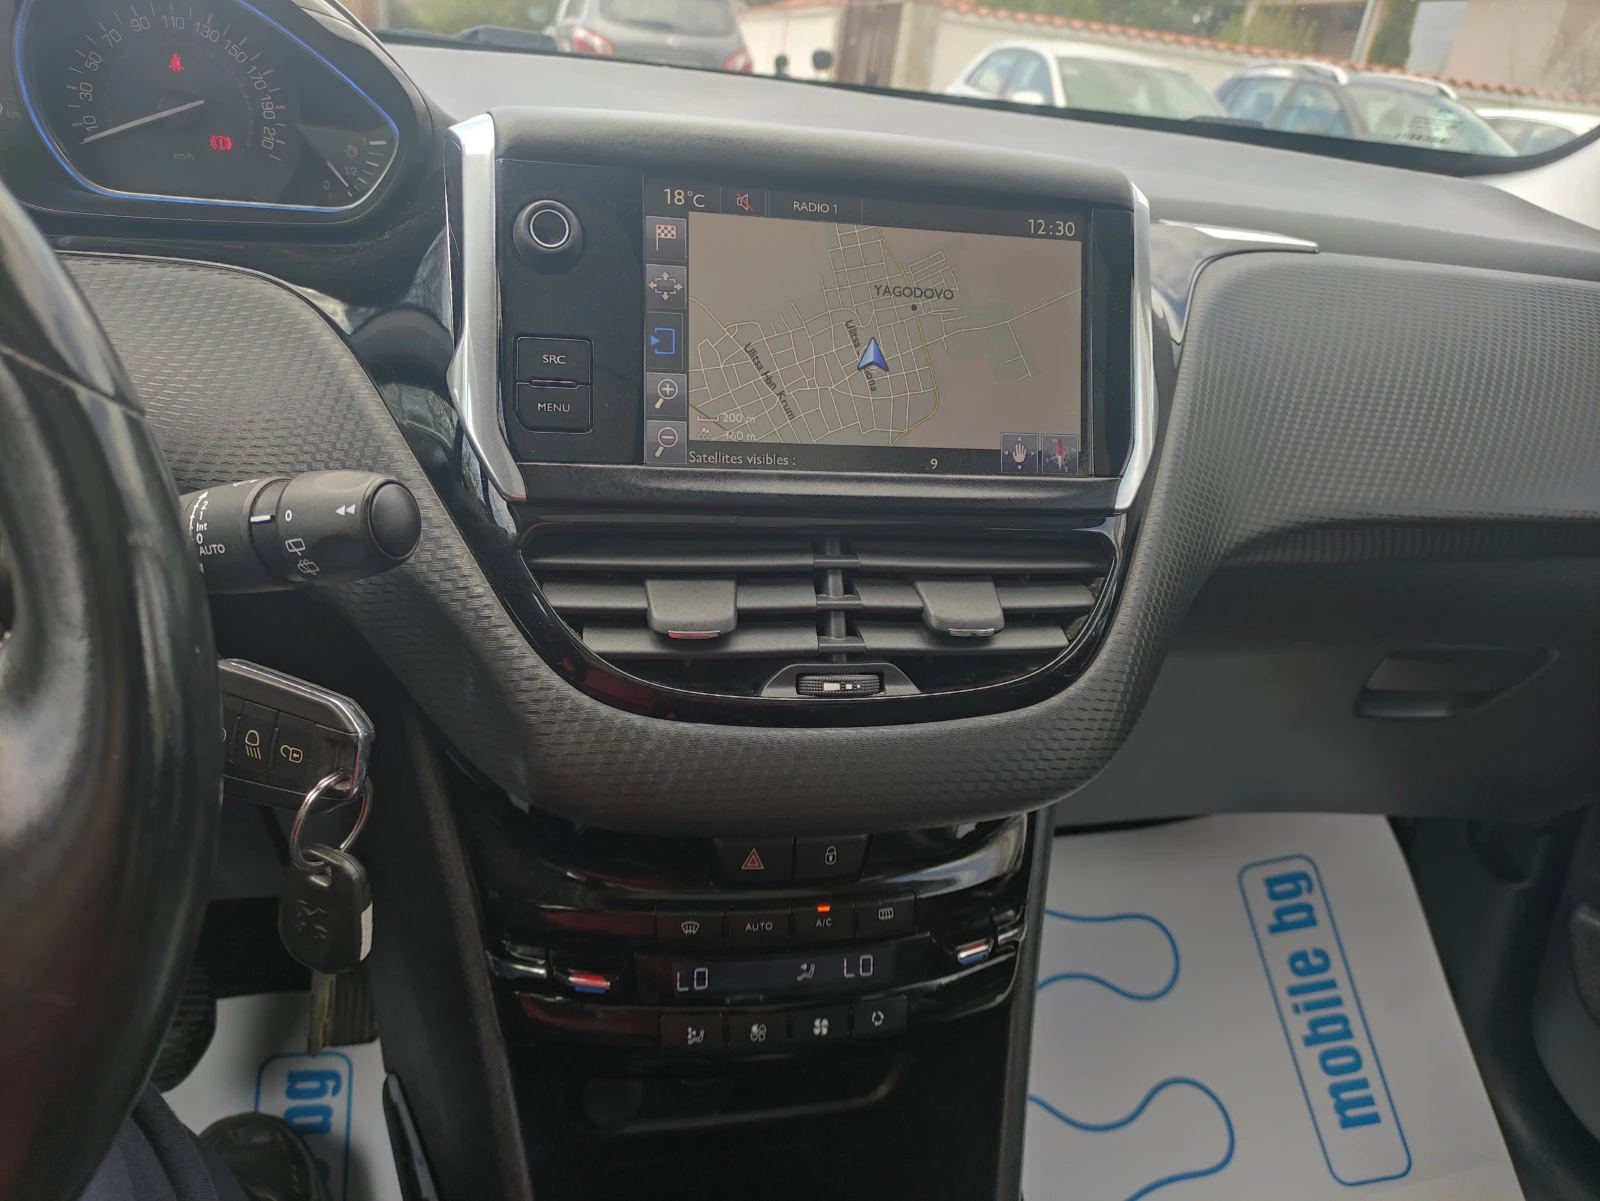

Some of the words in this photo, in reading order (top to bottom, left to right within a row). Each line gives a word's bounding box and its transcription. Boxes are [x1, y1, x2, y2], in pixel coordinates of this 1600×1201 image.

[130, 16, 151, 32] 90
[161, 15, 185, 29] 110
[102, 29, 122, 47] 70
[194, 22, 220, 43] 130
[224, 39, 248, 63] 150
[84, 51, 102, 71] 50
[247, 65, 267, 90] 170
[79, 82, 93, 101] 30
[260, 95, 276, 120] 190
[82, 115, 98, 132] 10
[261, 126, 276, 150] 210
[173, 152, 194, 161] km/h
[345, 166, 358, 176] 1/2
[793, 201, 830, 213] RADIO
[833, 204, 838, 214] 1
[1027, 218, 1076, 236] 12:30
[873, 284, 954, 300] YAGODOVO
[845, 319, 860, 348] Ulitsa
[542, 354, 566, 365] SRC
[744, 342, 764, 371] Ulitsa
[761, 370, 777, 390] Han
[776, 390, 795, 420] Krum
[537, 402, 570, 412] MENU
[722, 413, 744, 423] 200
[746, 433, 757, 441] m
[689, 451, 743, 464] Satellites
[747, 453, 789, 465] visibles
[930, 458, 938, 469] 9
[201, 500, 208, 510] 2
[199, 511, 204, 521] 1
[196, 522, 208, 532] Int
[199, 543, 225, 556] AUTO
[1263, 870, 1318, 934] bg
[745, 922, 773, 932] AUTO
[815, 917, 832, 928] A/C
[1285, 946, 1382, 1129] mobile
